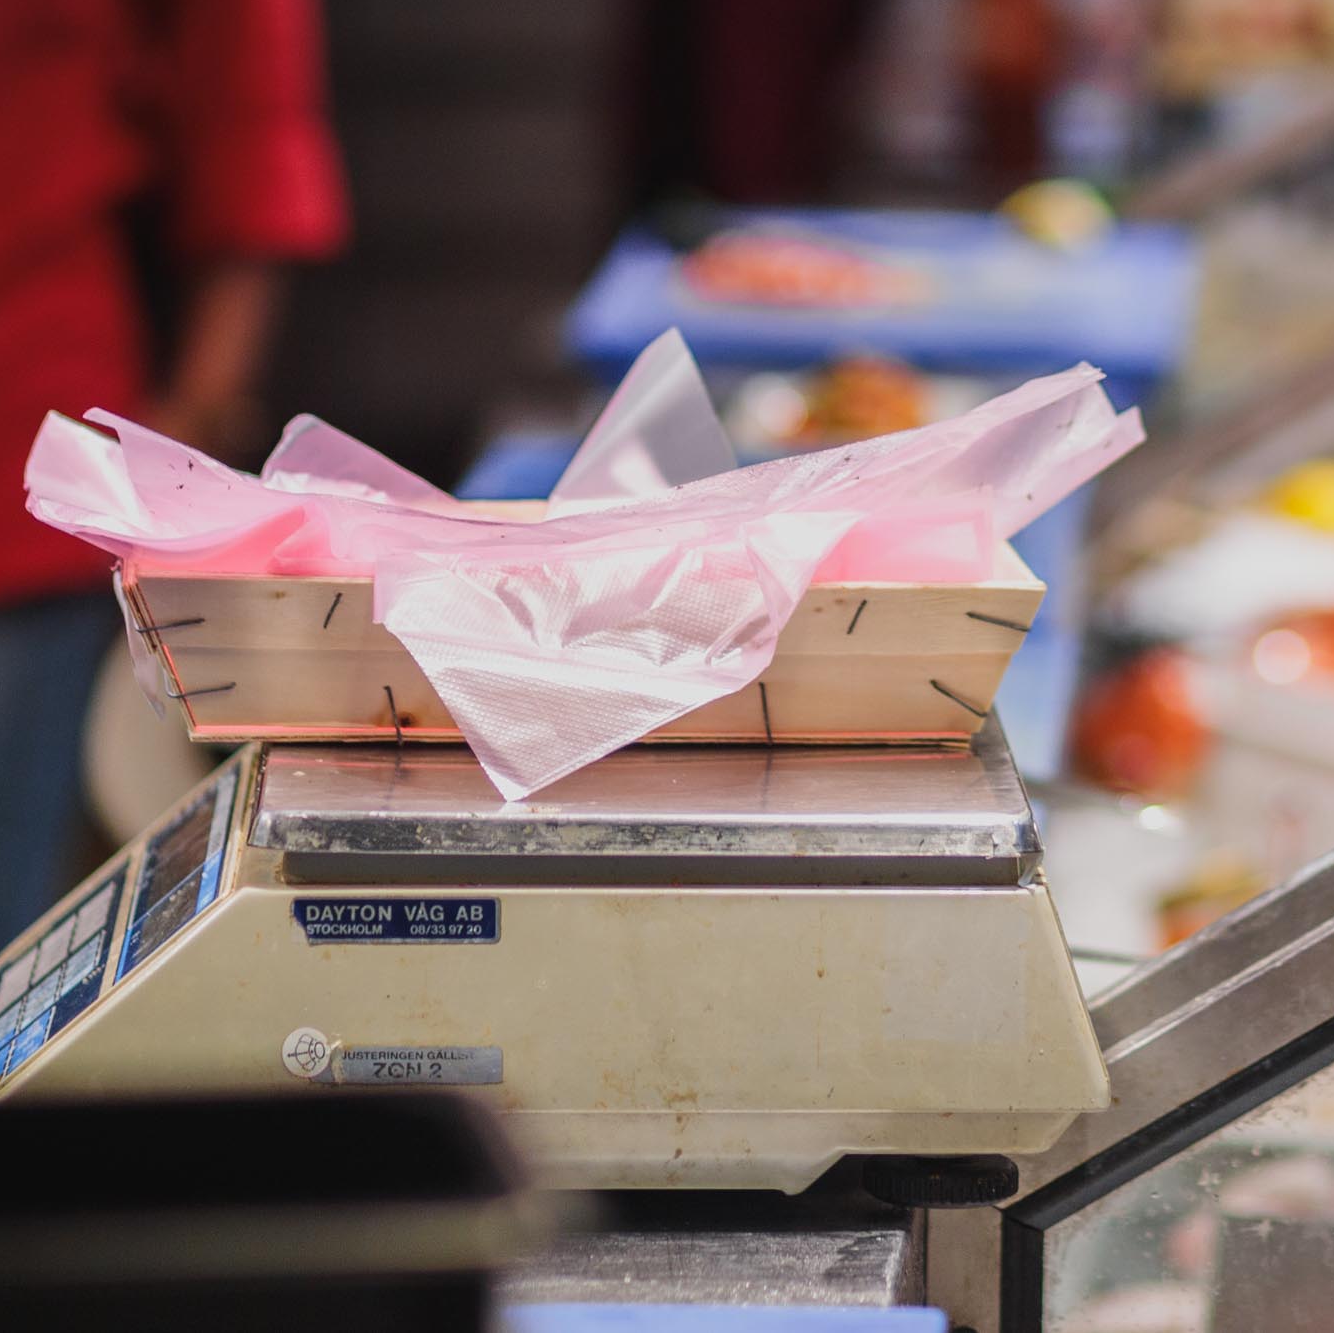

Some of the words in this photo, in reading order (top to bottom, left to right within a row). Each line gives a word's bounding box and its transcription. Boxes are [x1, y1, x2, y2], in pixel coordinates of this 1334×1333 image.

[305, 905, 392, 922] DAYTON
[404, 901, 445, 922] VÅG
[455, 905, 484, 922] AB
[306, 923, 383, 935] STOCKHOLM
[410, 924, 446, 936] 08/33
[448, 924, 464, 936] 97
[466, 924, 483, 936] 20
[341, 1050, 422, 1061] JUSTERINGEN
[427, 1048, 475, 1061] GÄLL
[429, 1062, 443, 1079] 2
